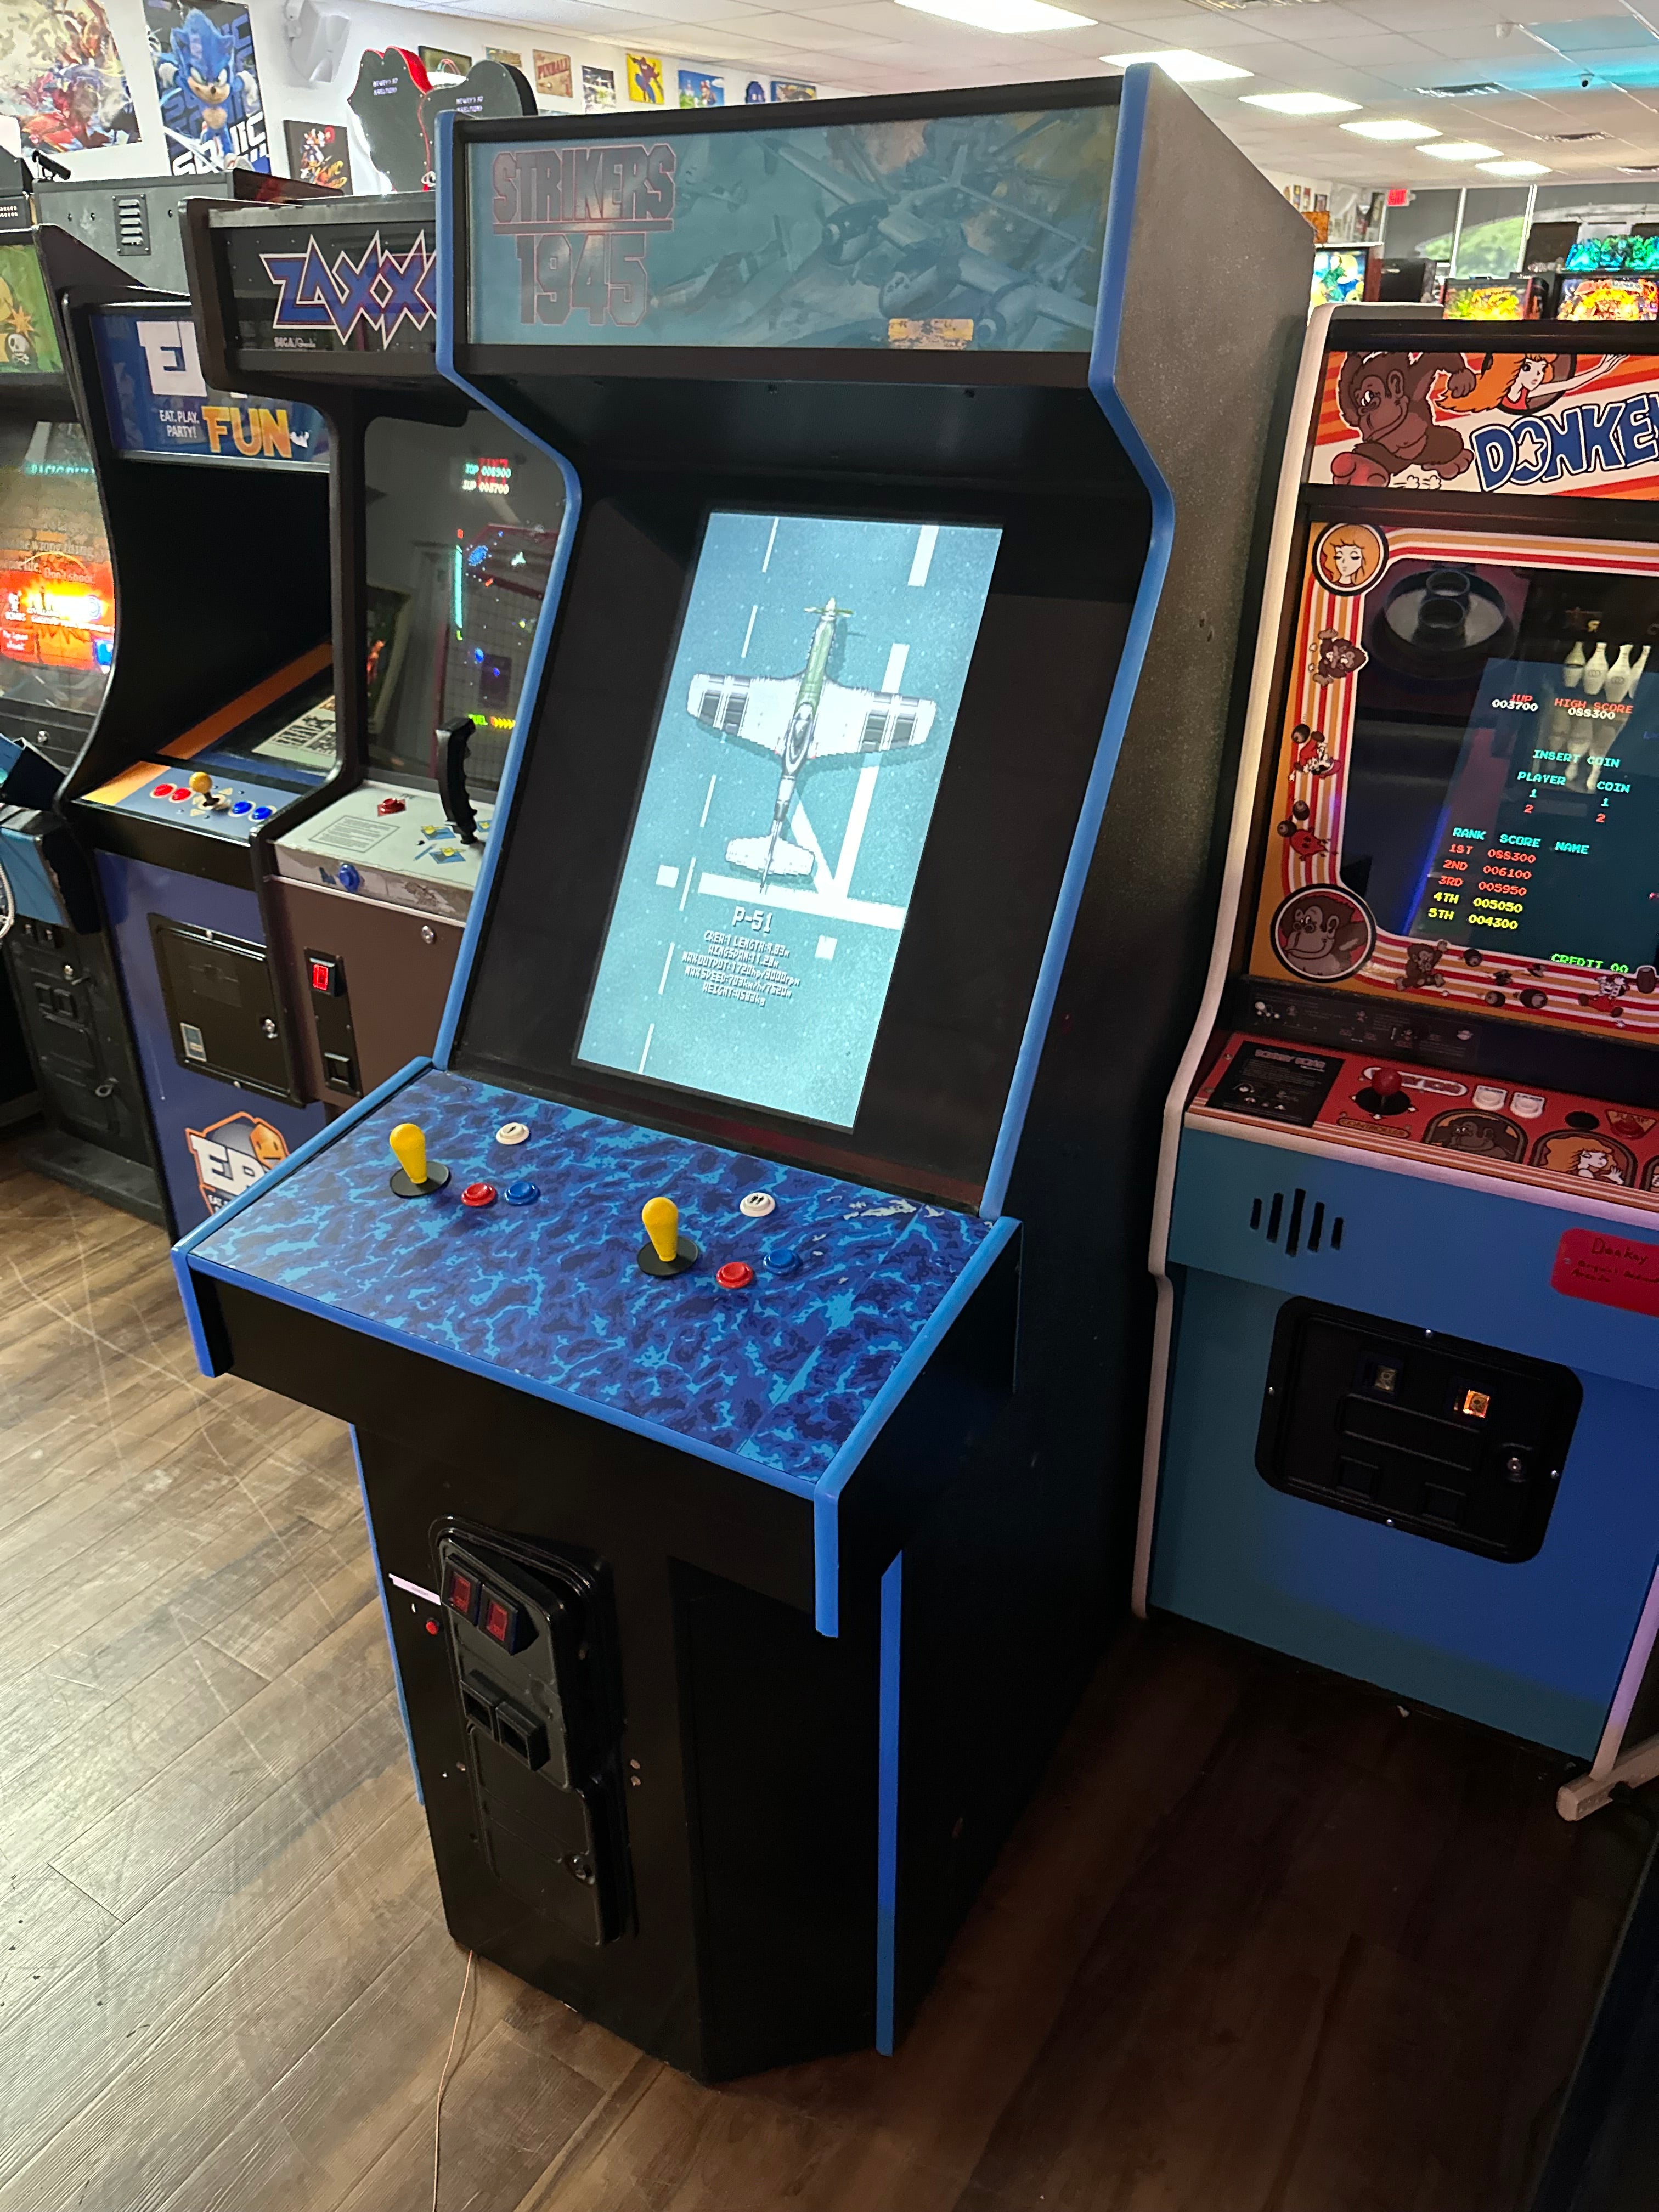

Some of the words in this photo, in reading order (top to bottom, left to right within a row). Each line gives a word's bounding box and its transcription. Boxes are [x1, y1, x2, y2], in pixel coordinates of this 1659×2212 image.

[492, 143, 676, 224] STRIKERS
[259, 229, 437, 351] ZAXX
[515, 232, 647, 327] 1945
[159, 410, 177, 422] EAT.
[177, 411, 200, 424] PLAY.
[166, 425, 197, 438] PARTY!
[201, 405, 292, 459] FUN
[1470, 392, 1659, 493] DONKE
[1491, 699, 1538, 712] 003700
[1510, 693, 1533, 702] 1UP
[1554, 698, 1587, 709] HIGH
[1593, 702, 1634, 714] SCORE
[1532, 749, 1581, 763] INSERT
[1587, 755, 1621, 768] COIN
[1517, 771, 1567, 786] PLAYER
[1596, 781, 1631, 793] COIN
[1529, 789, 1537, 798] 1
[1601, 798, 1609, 807] 1
[1523, 804, 1534, 814] 2
[1595, 813, 1606, 823] 2
[1449, 844, 1474, 855] 1ST
[1452, 827, 1487, 840] RANK
[1499, 833, 1542, 848] SCORE
[1554, 840, 1589, 855] NAME
[1443, 860, 1468, 871] 2ND
[1482, 865, 1532, 880] 006100
[1438, 876, 1464, 887] 3RD
[1478, 881, 1527, 896] 005950
[1434, 891, 1459, 904] 4TH
[1472, 897, 1523, 913] 005050
[732, 906, 772, 933] P-51
[1428, 908, 1455, 921] 5TH
[1468, 914, 1519, 930] 004300
[1551, 953, 1604, 969] CREDIT
[1610, 963, 1629, 974] 00
[1592, 1238, 1648, 1266] Donkey
